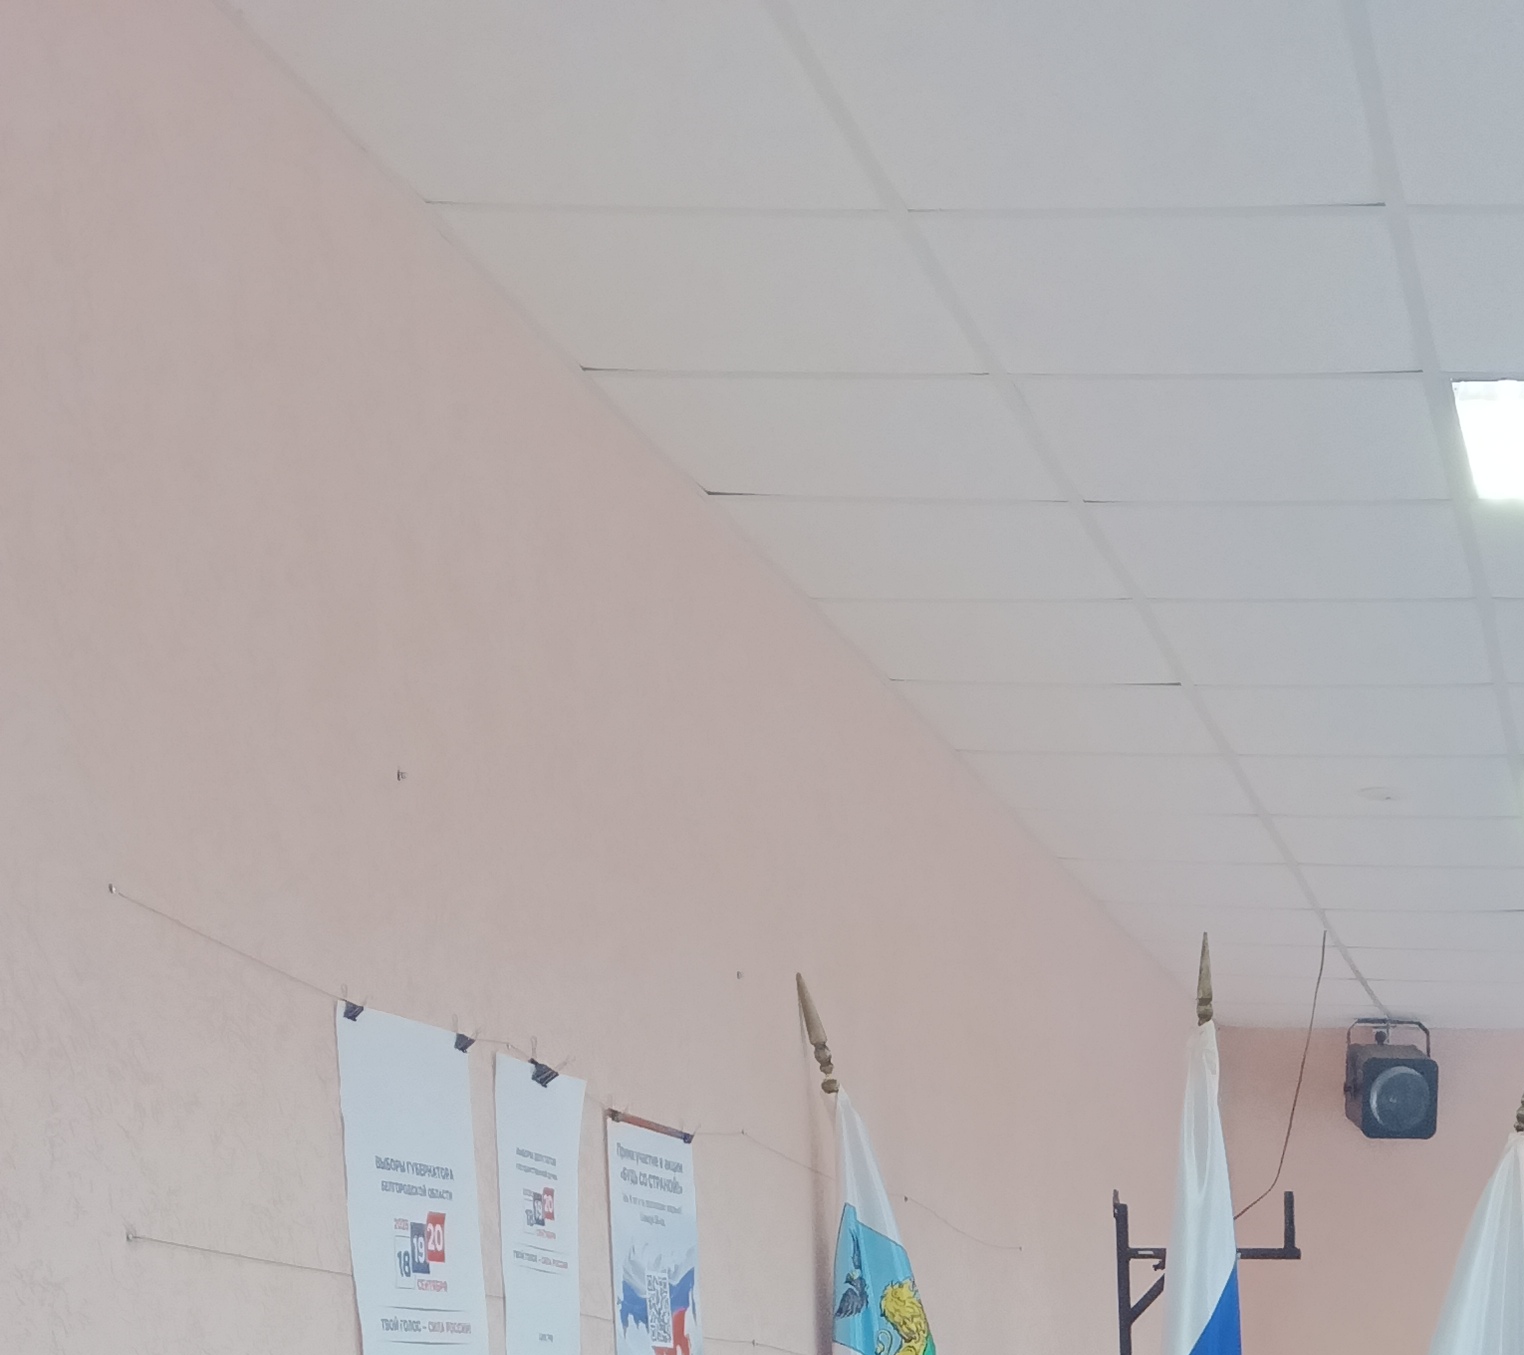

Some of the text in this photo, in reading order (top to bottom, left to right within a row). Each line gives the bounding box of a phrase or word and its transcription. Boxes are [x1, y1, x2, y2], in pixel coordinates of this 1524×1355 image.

[375, 1155, 454, 1181] ВЫБОРЫ ГУБЕРНАТОРА
[413, 1235, 425, 1264] 19
[427, 1223, 443, 1251] 20
[397, 1250, 411, 1277] 18
